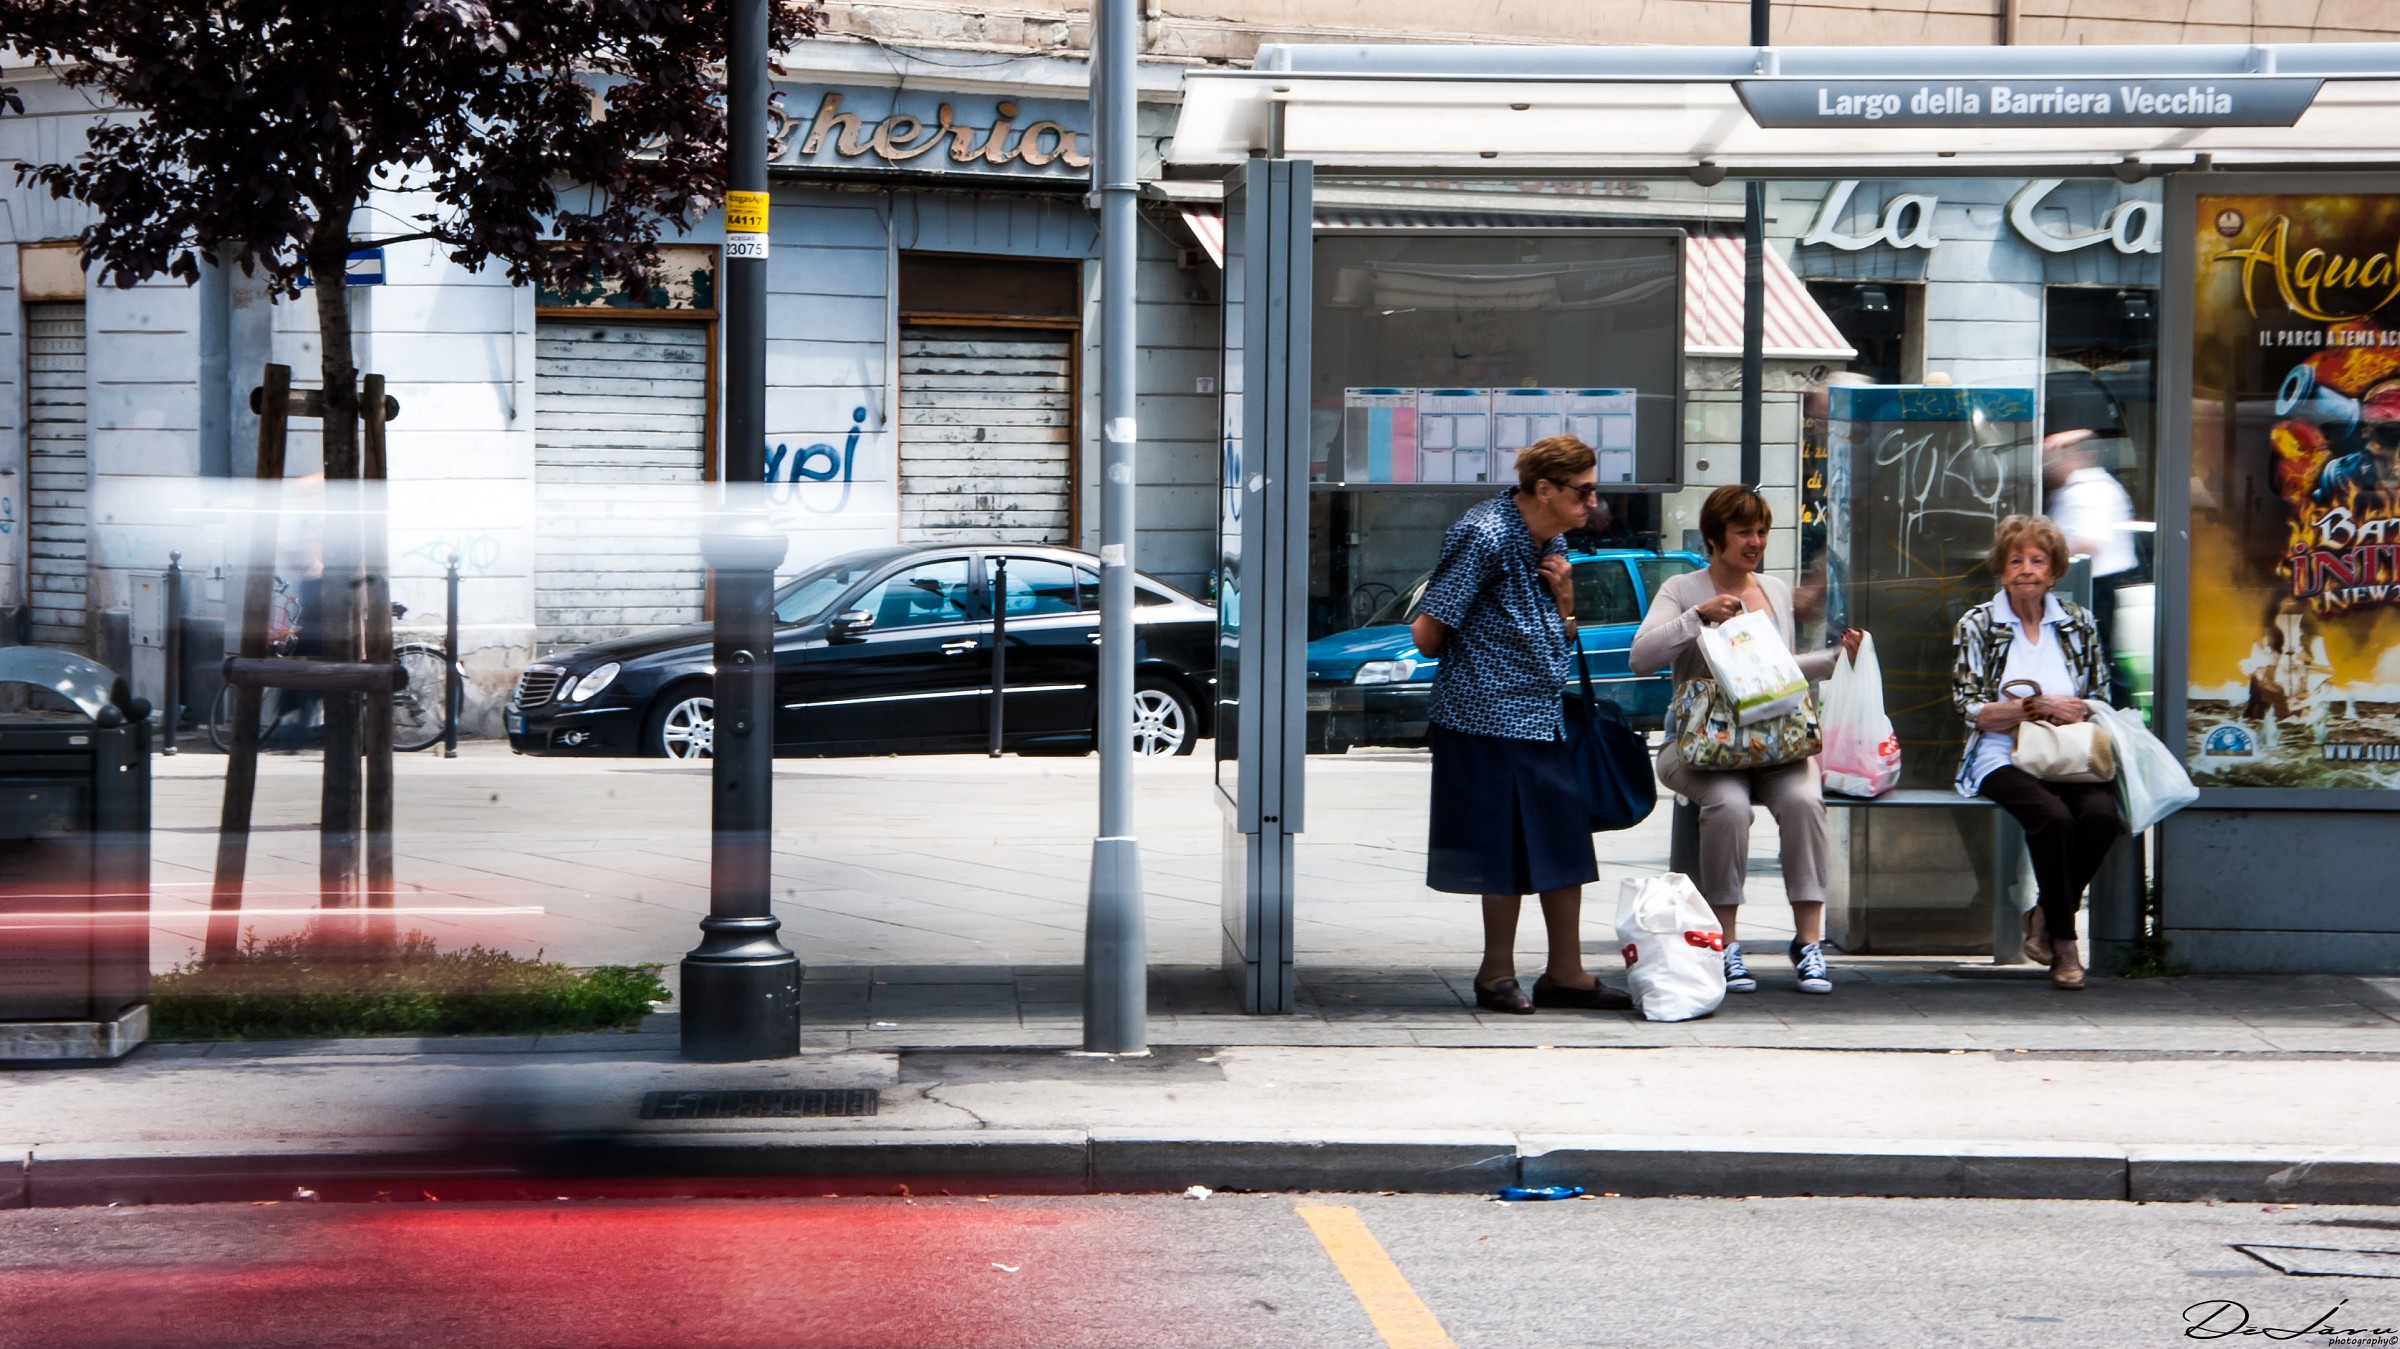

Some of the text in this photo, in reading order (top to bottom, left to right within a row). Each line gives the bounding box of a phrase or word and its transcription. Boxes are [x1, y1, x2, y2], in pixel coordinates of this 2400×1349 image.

[1818, 85, 2232, 120] Largo della Barriera Vecchia
[1802, 180, 1940, 251] La
[726, 243, 763, 255] 23075
[2214, 214, 2400, 321] Aqua
[2259, 330, 2273, 346] IL
[2277, 330, 2322, 346] PARCO
[2326, 330, 2335, 346] A
[2340, 330, 2375, 346] TEMA
[2323, 584, 2390, 612] NEW
